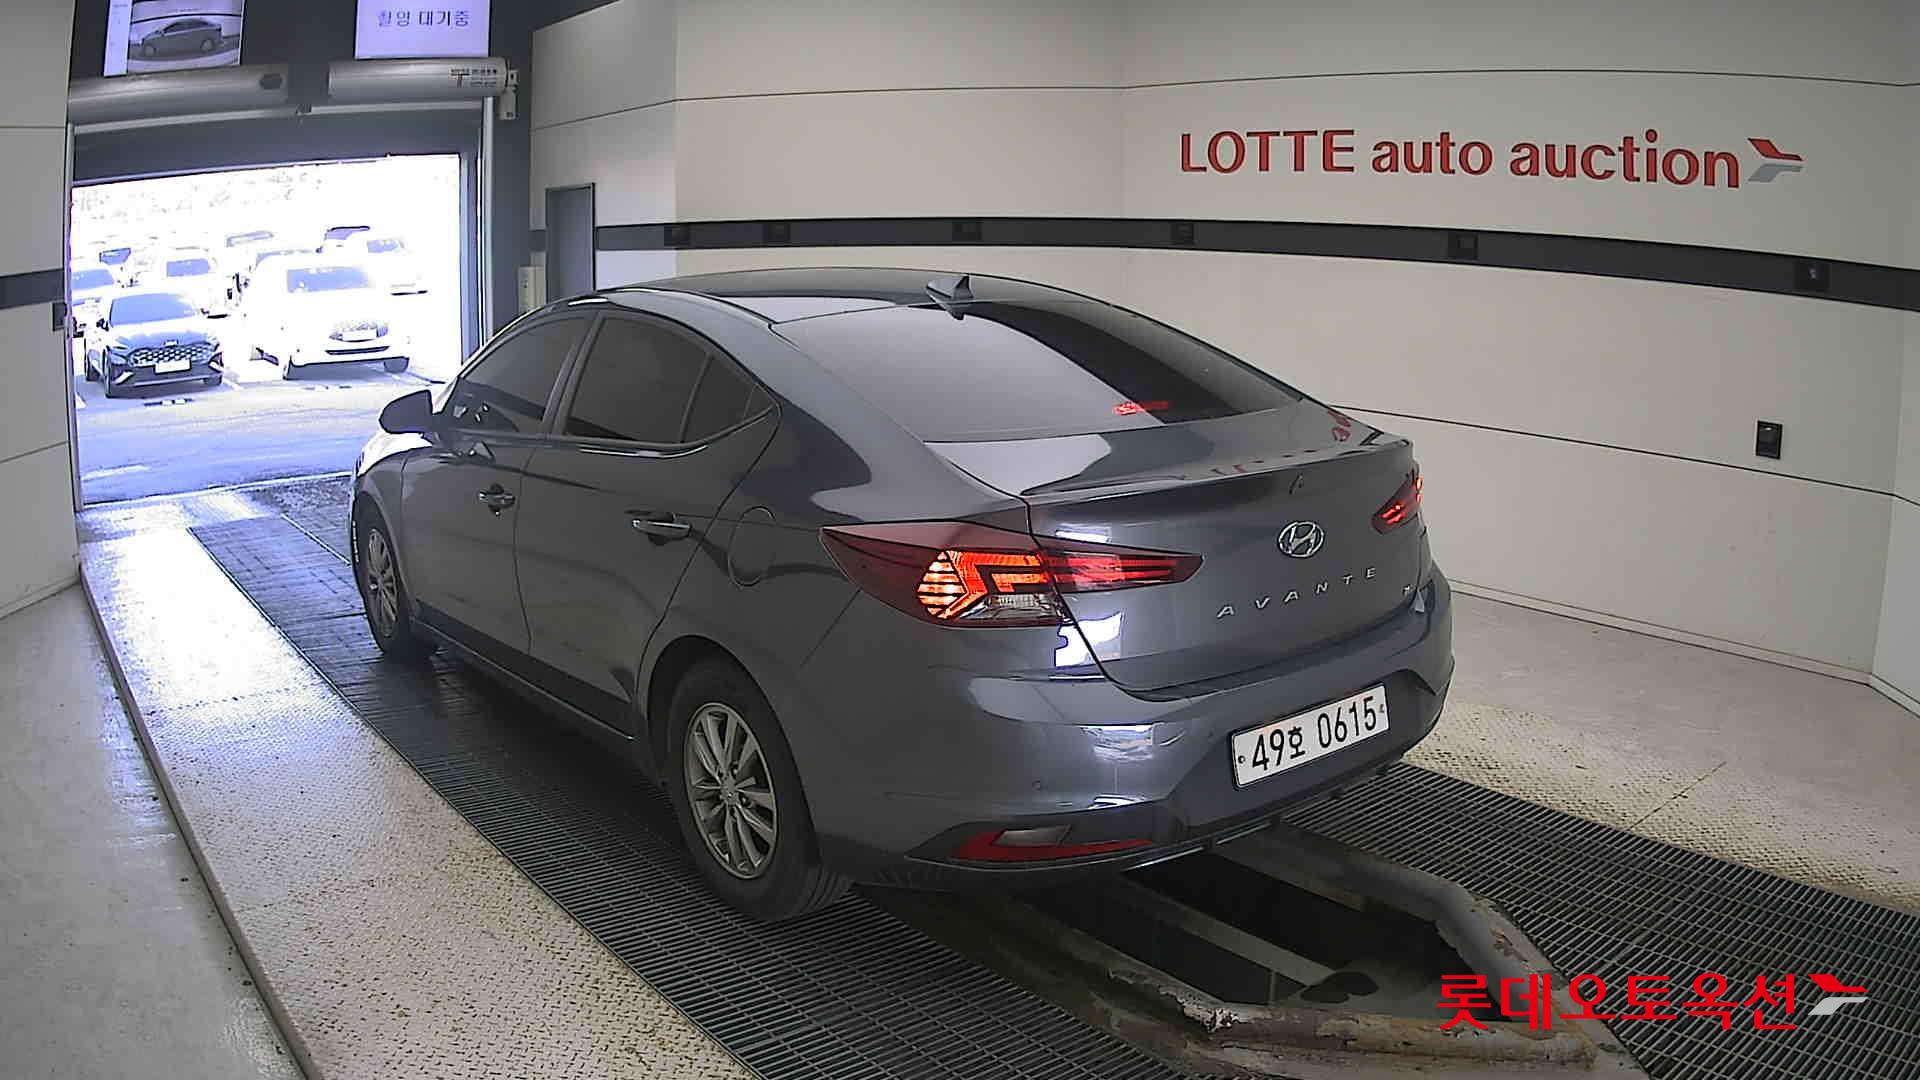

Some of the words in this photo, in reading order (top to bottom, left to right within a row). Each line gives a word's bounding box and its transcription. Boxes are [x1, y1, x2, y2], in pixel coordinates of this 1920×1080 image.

[419, 10, 469, 27] 대기중
[1181, 130, 1355, 174] LOTTE
[1371, 132, 1494, 177] auto
[1510, 130, 1740, 189] auction
[1216, 567, 1377, 619] AVANTE
[1252, 726, 1306, 771] 49호
[1317, 696, 1377, 748] 0615
